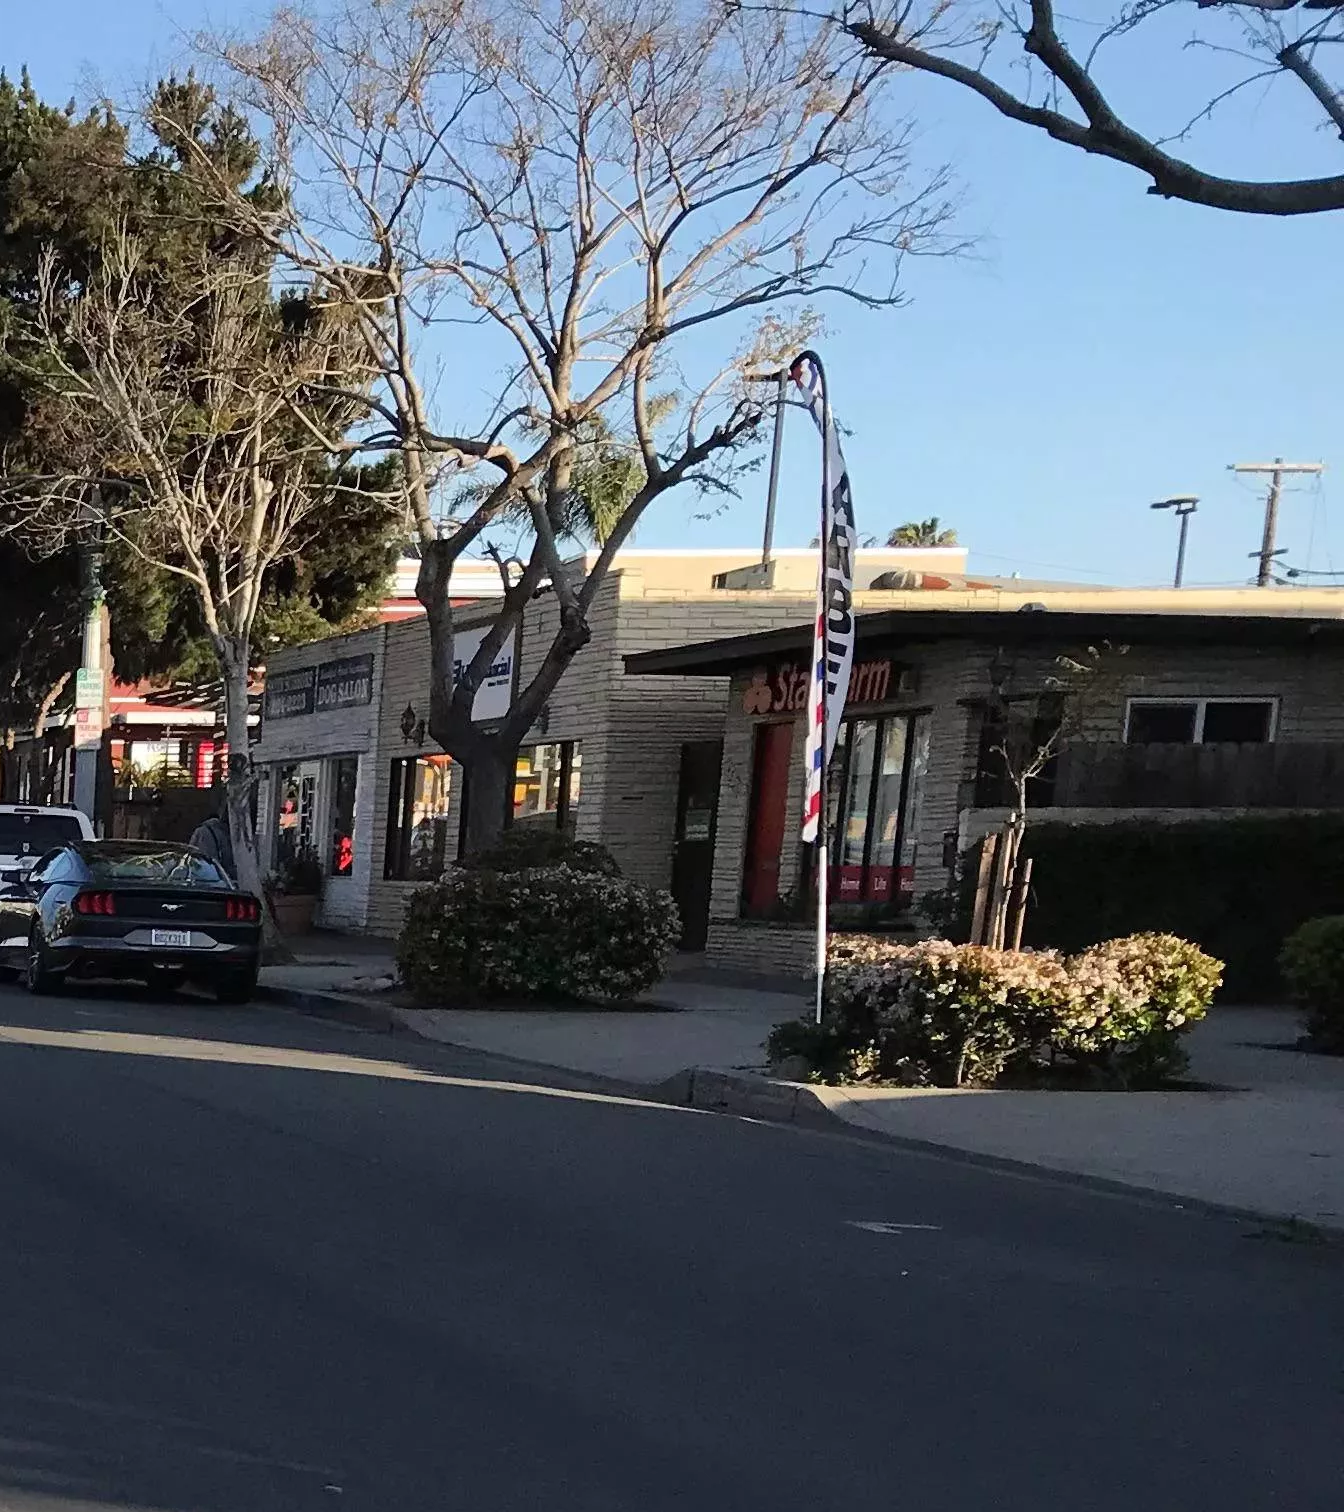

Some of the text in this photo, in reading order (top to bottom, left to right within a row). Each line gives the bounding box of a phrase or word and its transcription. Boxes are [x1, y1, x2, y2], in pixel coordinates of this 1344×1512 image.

[317, 685, 338, 705] DOG
[337, 678, 369, 702] SALON
[773, 663, 811, 711] Sta
